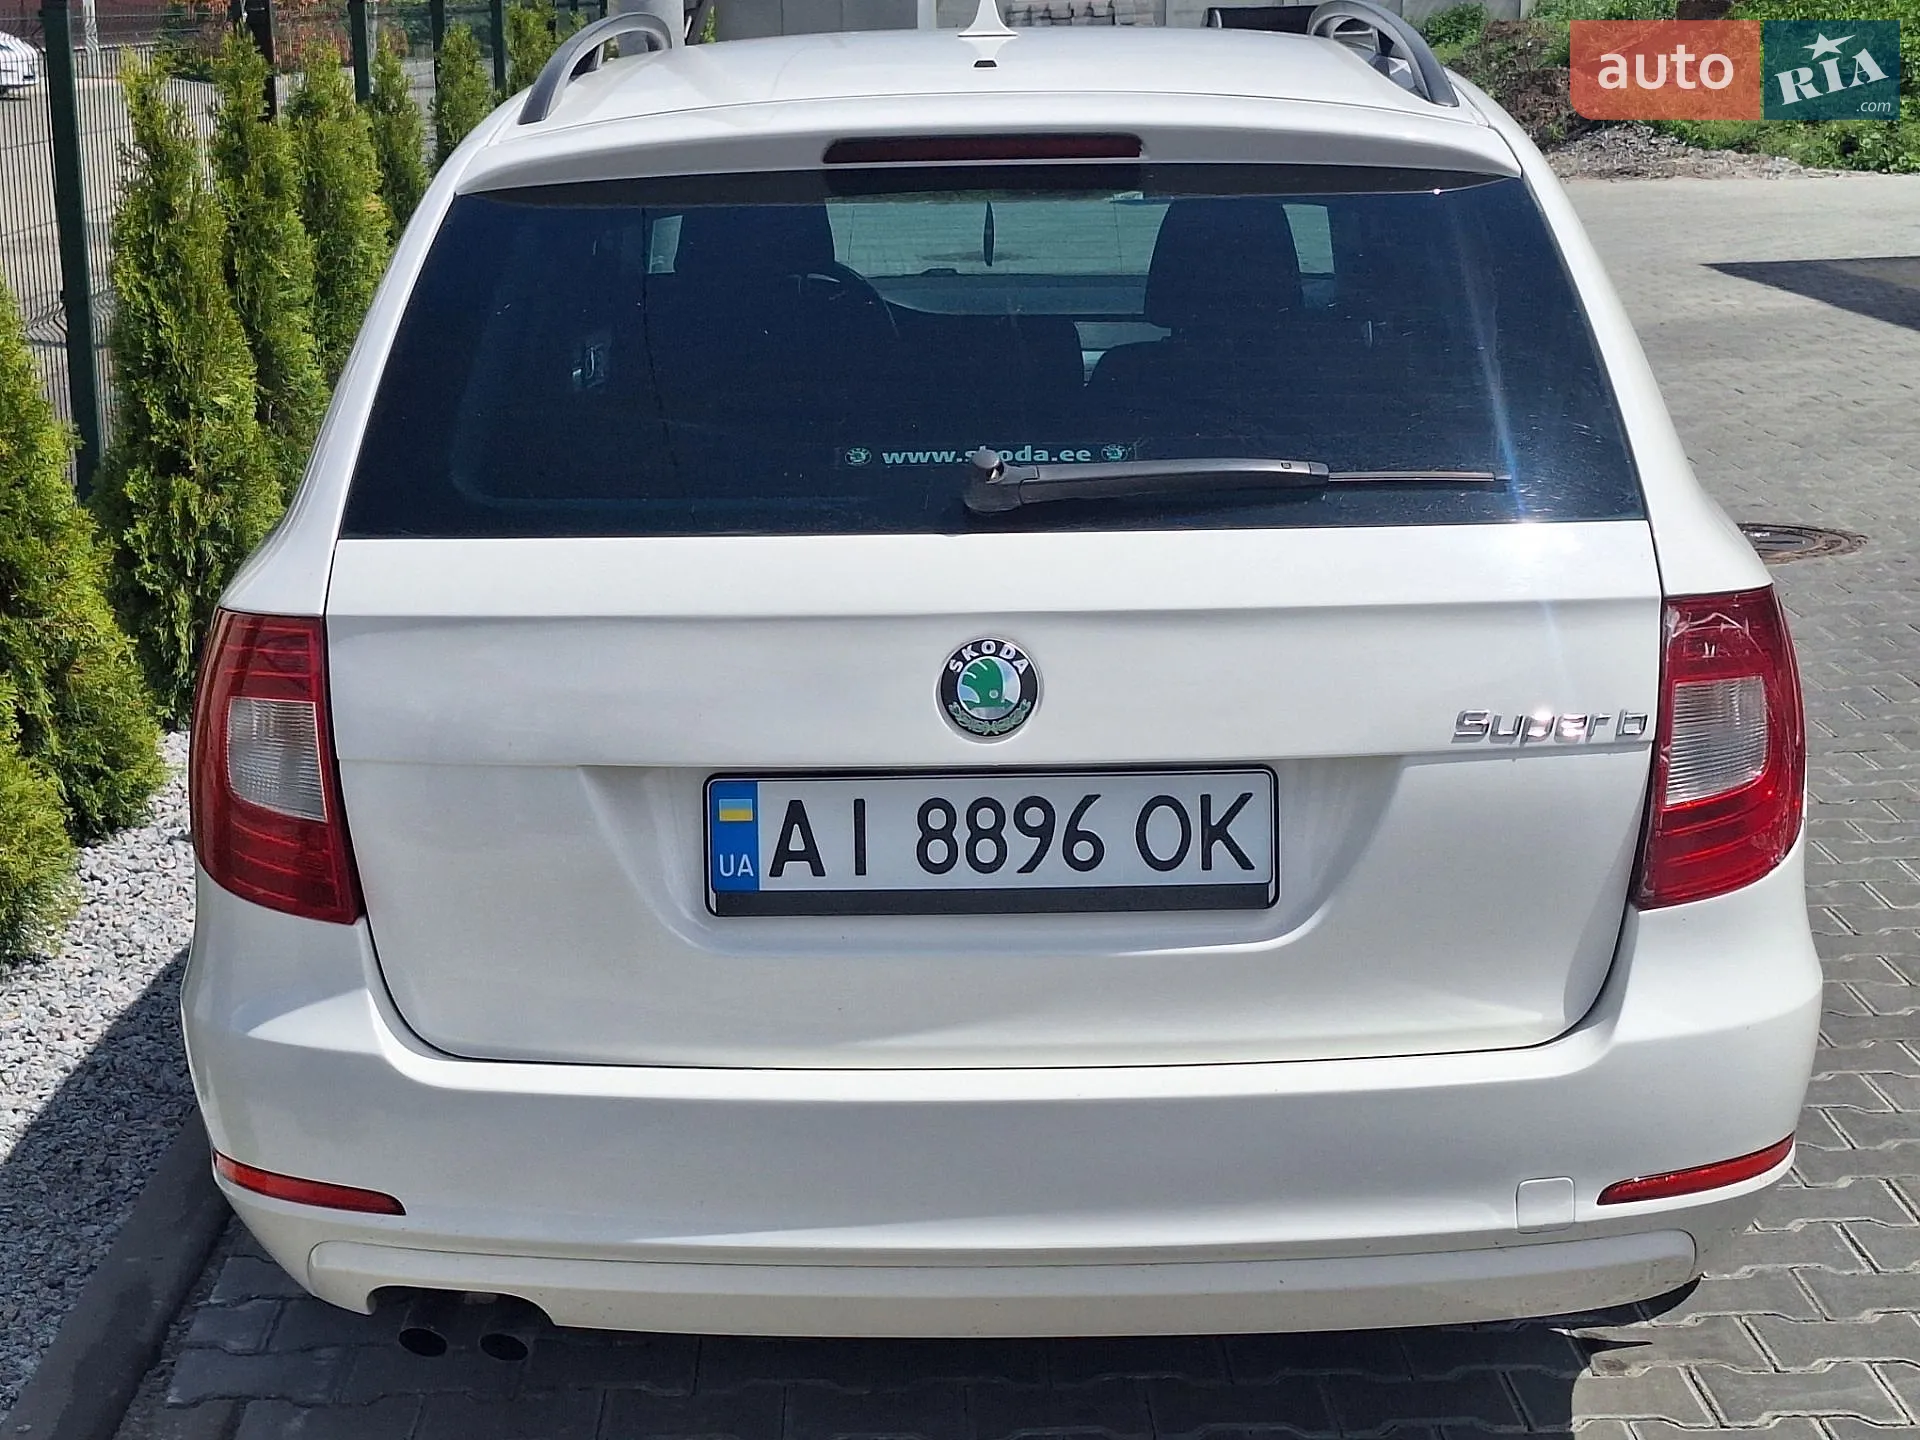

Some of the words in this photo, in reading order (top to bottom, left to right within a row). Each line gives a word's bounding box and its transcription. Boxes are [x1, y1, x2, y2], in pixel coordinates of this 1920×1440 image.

[882, 445, 1092, 463] www.soda.ee
[1451, 708, 1649, 748] Superb
[768, 799, 867, 877] AI
[916, 794, 1105, 875] 8896
[1135, 792, 1256, 872] OK
[719, 854, 754, 878] UA
